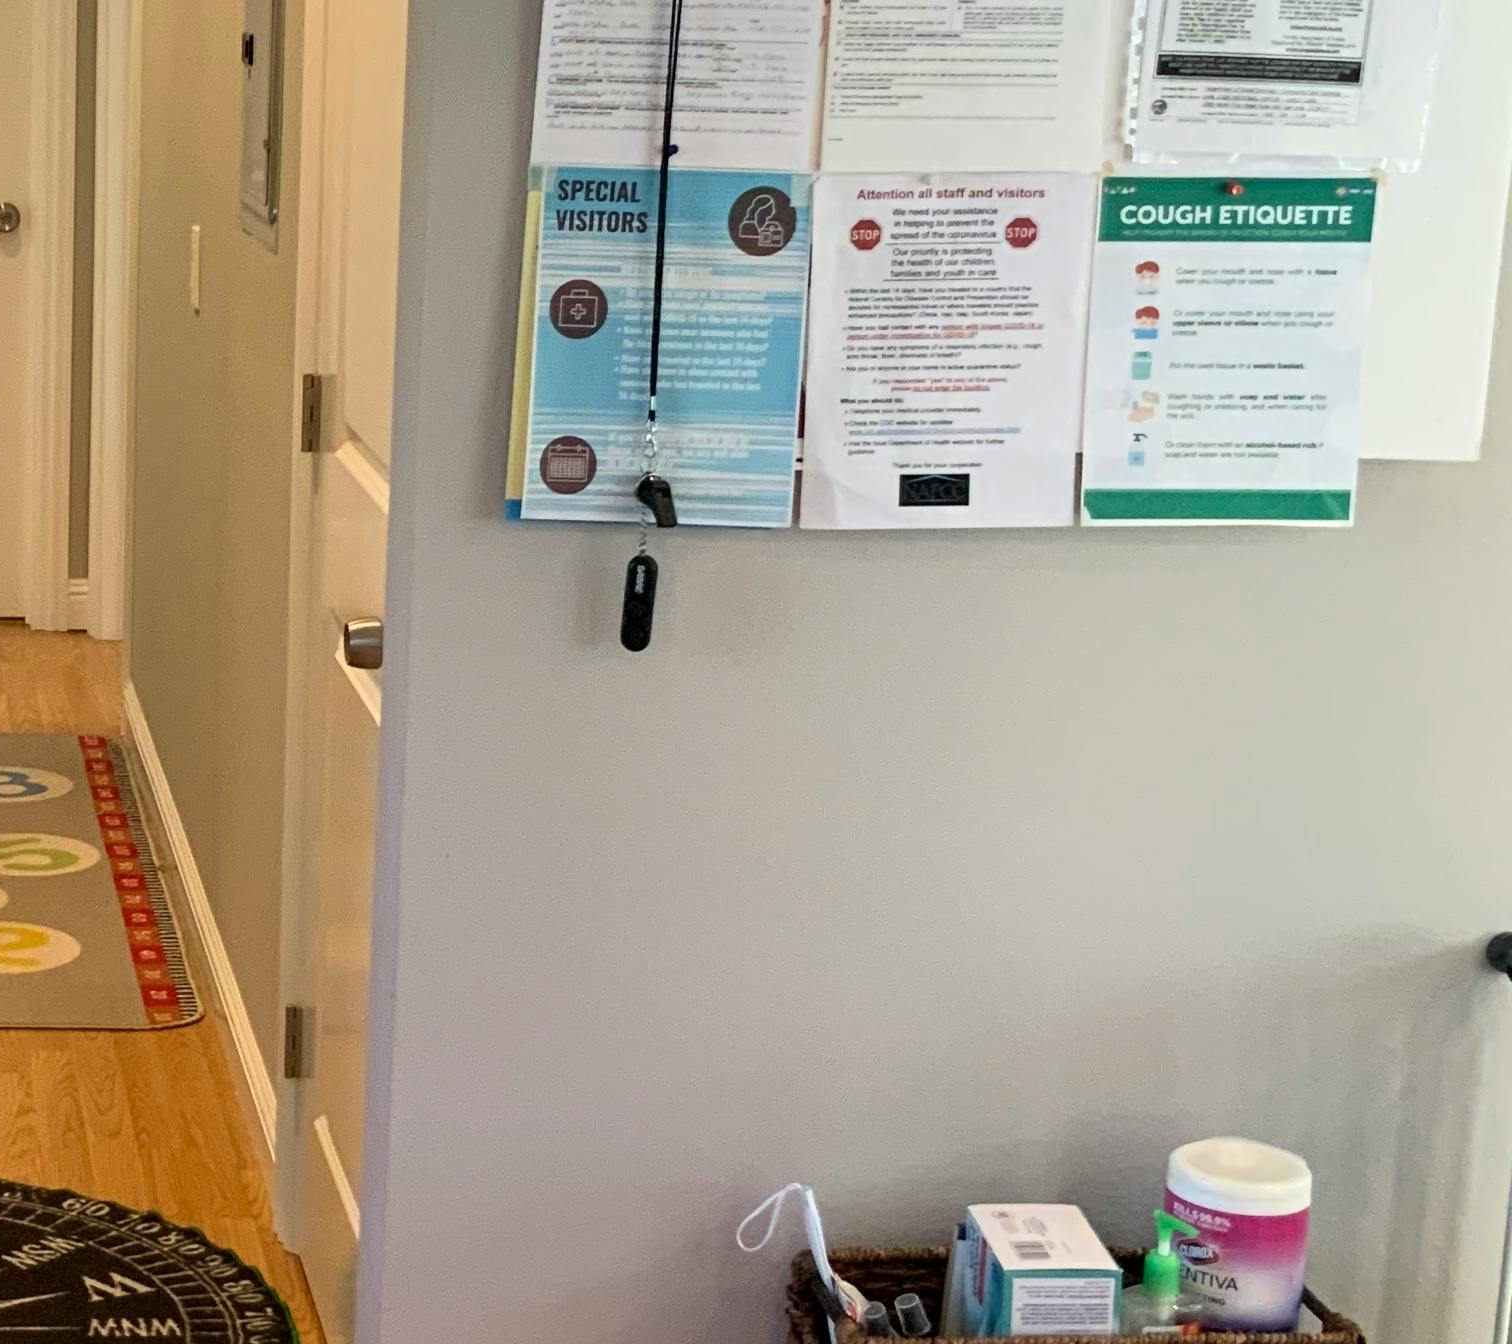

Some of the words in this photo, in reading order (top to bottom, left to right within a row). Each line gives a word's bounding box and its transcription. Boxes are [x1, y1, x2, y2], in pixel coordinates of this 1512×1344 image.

[558, 179, 641, 203] SPECIAL
[856, 189, 914, 200] Attention
[917, 188, 932, 198] all
[936, 187, 966, 198] staff
[968, 187, 993, 198] and
[997, 188, 1045, 198] visitors
[892, 208, 906, 216] We
[908, 208, 930, 216] need
[932, 209, 951, 217] your
[953, 207, 998, 215] assistance
[1119, 205, 1212, 225] COUGH
[1218, 205, 1353, 225] ETIQUETTE
[555, 209, 648, 233] VISITORS
[903, 219, 934, 228] helping
[946, 219, 979, 228] prevent
[980, 218, 994, 226] the
[851, 229, 880, 241] STOP
[890, 231, 919, 241] spread
[947, 230, 997, 238] coronavirus
[1006, 227, 1036, 238] STOP
[892, 248, 908, 256] Our
[910, 248, 939, 257] priority
[950, 247, 992, 256] protecting
[891, 259, 904, 267] the
[906, 259, 932, 267] health
[890, 270, 922, 278] families
[943, 270, 966, 278] youth
[978, 269, 997, 277] care
[1172, 320, 1195, 328] upper
[1179, 1244, 1214, 1259] CLOROX
[80, 1271, 158, 1303] W
[88, 1317, 182, 1338] WNW
